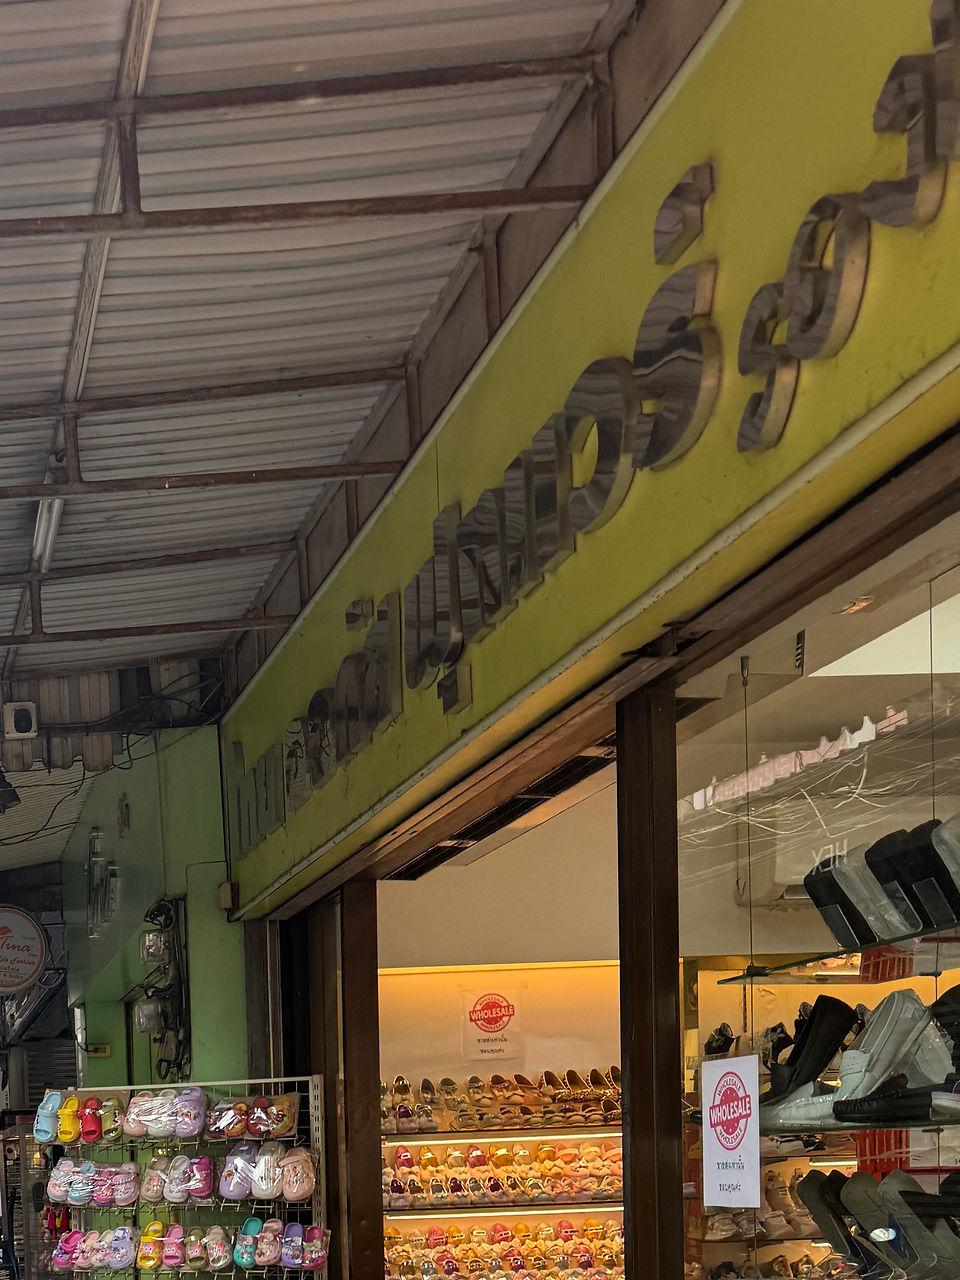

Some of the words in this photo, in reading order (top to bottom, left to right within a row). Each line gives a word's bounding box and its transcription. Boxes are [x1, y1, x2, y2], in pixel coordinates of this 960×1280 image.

[0, 935, 32, 953] Tina
[470, 1005, 514, 1021] WHOLESALE
[710, 1097, 751, 1124] WHOLESALE
